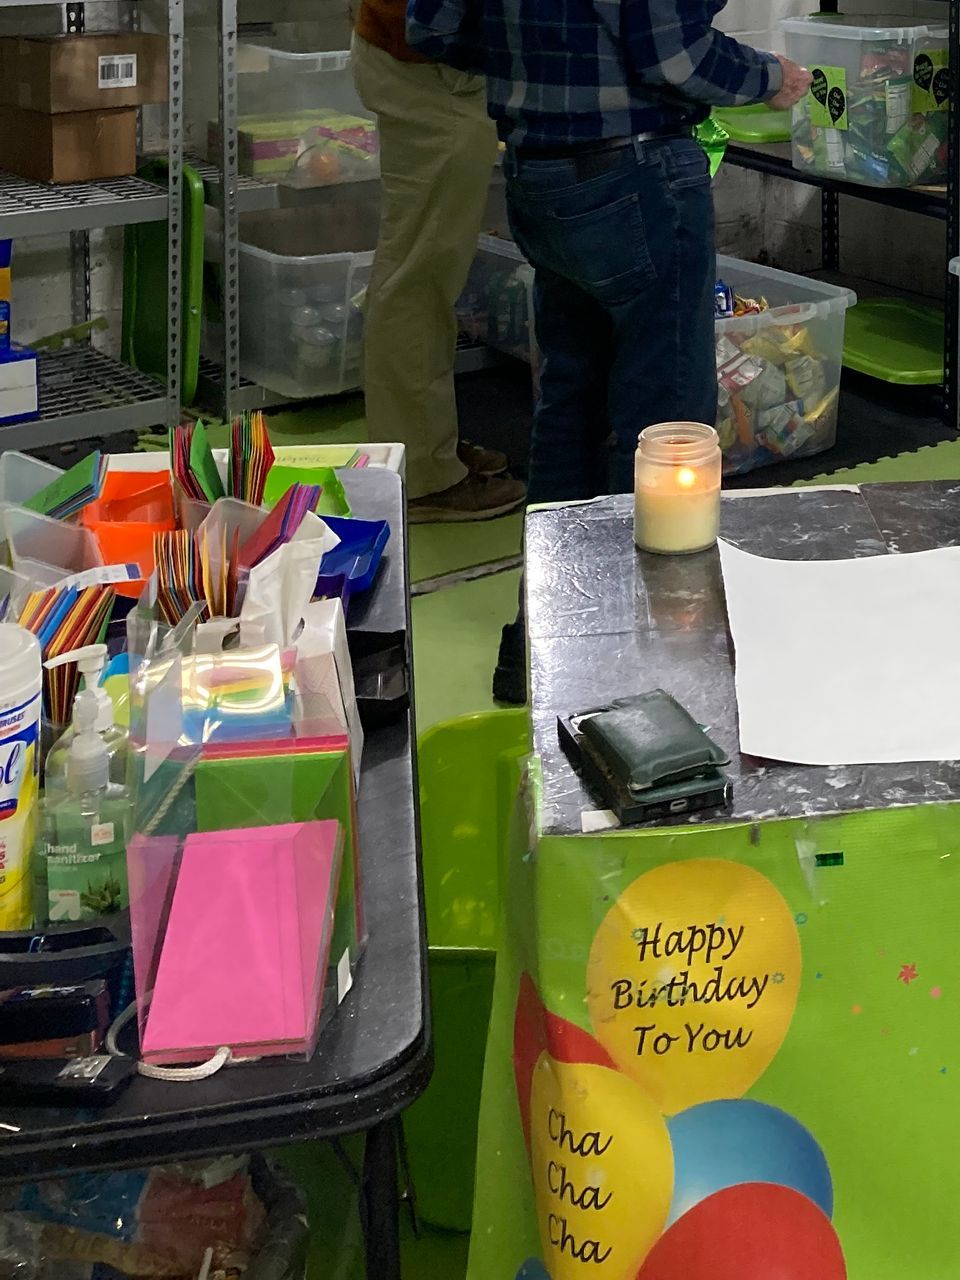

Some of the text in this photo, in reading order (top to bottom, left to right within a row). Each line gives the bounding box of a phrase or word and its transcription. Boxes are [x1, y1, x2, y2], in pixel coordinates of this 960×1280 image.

[47, 843, 77, 854] hand
[637, 922, 744, 966] Happy
[611, 966, 768, 1010] Birthday
[633, 1023, 753, 1056] To You
[548, 1108, 614, 1158] Cha
[548, 1160, 613, 1211] Cha
[548, 1213, 613, 1264] Cha
